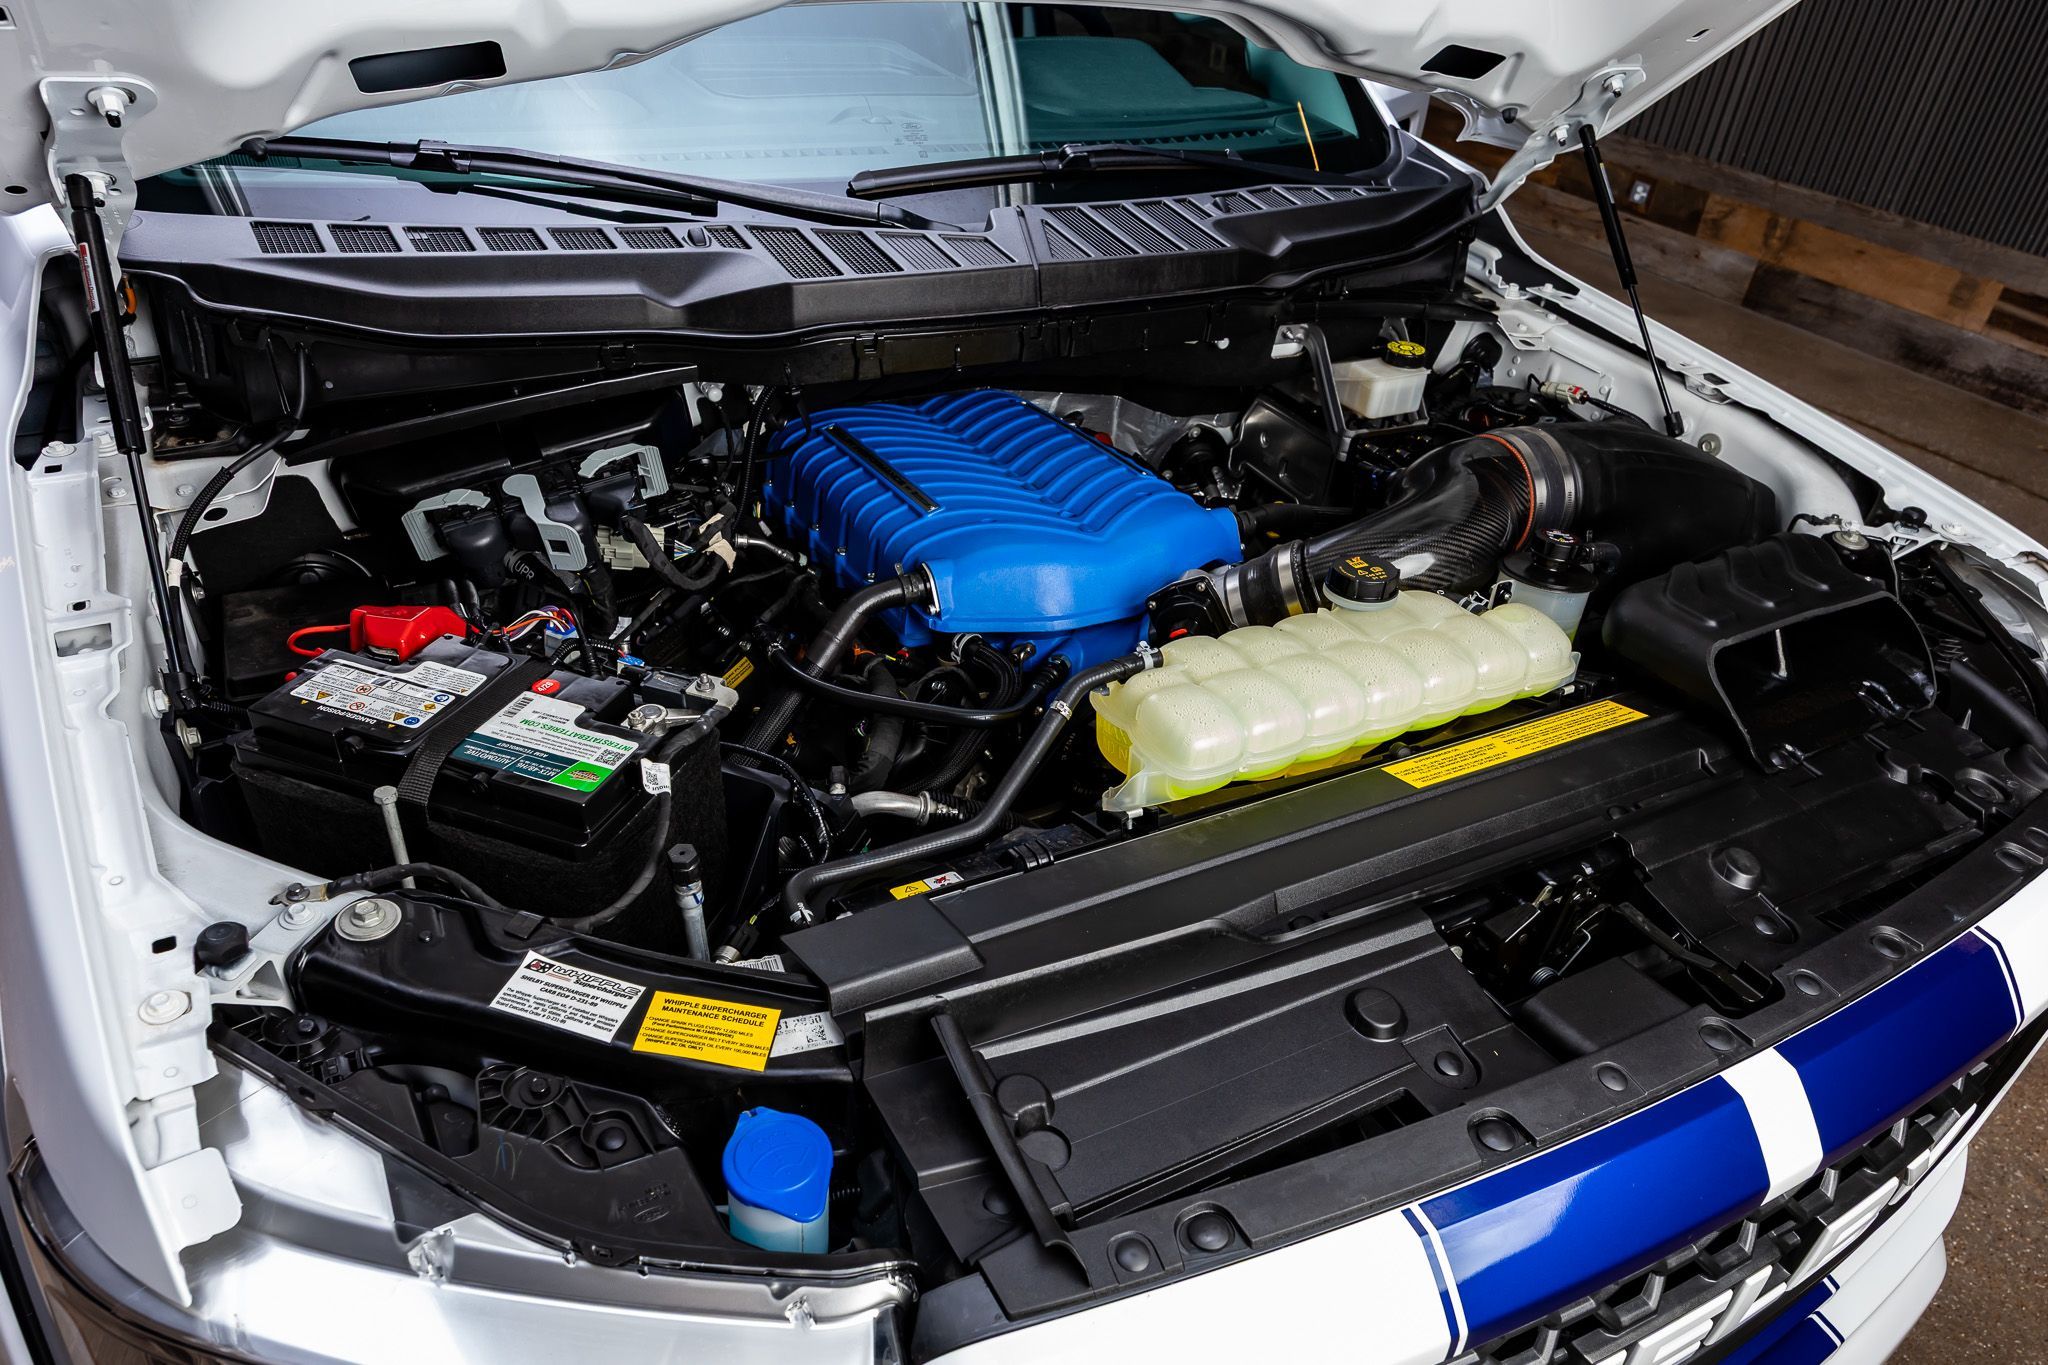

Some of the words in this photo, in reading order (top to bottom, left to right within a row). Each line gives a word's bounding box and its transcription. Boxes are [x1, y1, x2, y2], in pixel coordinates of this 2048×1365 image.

[515, 560, 535, 580] UPR
[517, 718, 634, 751] INTERSTATEBATTERIES.COM
[462, 748, 513, 764] AUTOMOTIVE
[494, 741, 535, 754] TECHNOLOGY
[551, 963, 642, 998] WHIPPLE
[572, 978, 633, 1001] Superchargers
[520, 974, 544, 985] SHELBY
[542, 980, 590, 999] SUPERCHARGER
[599, 997, 627, 1009] WHIPPLE
[539, 986, 557, 995] CARB
[556, 991, 570, 999] EO#
[569, 995, 598, 1007] D-231-89
[495, 999, 509, 1007] Board
[508, 1003, 529, 1013] Executive
[547, 1004, 568, 1013] California
[579, 1013, 595, 1021] Federal
[663, 998, 699, 1008] WHIPPLE
[701, 1004, 768, 1019] SUPERCHARGER
[562, 1014, 584, 1024] California
[661, 1005, 719, 1019] MAINTENANCE
[720, 1015, 764, 1027] SCHEDULE
[665, 1023, 695, 1031] Performance
[666, 1030, 707, 1040] SUPERCHARGER
[663, 1036, 705, 1046] SUPERCHARGER
